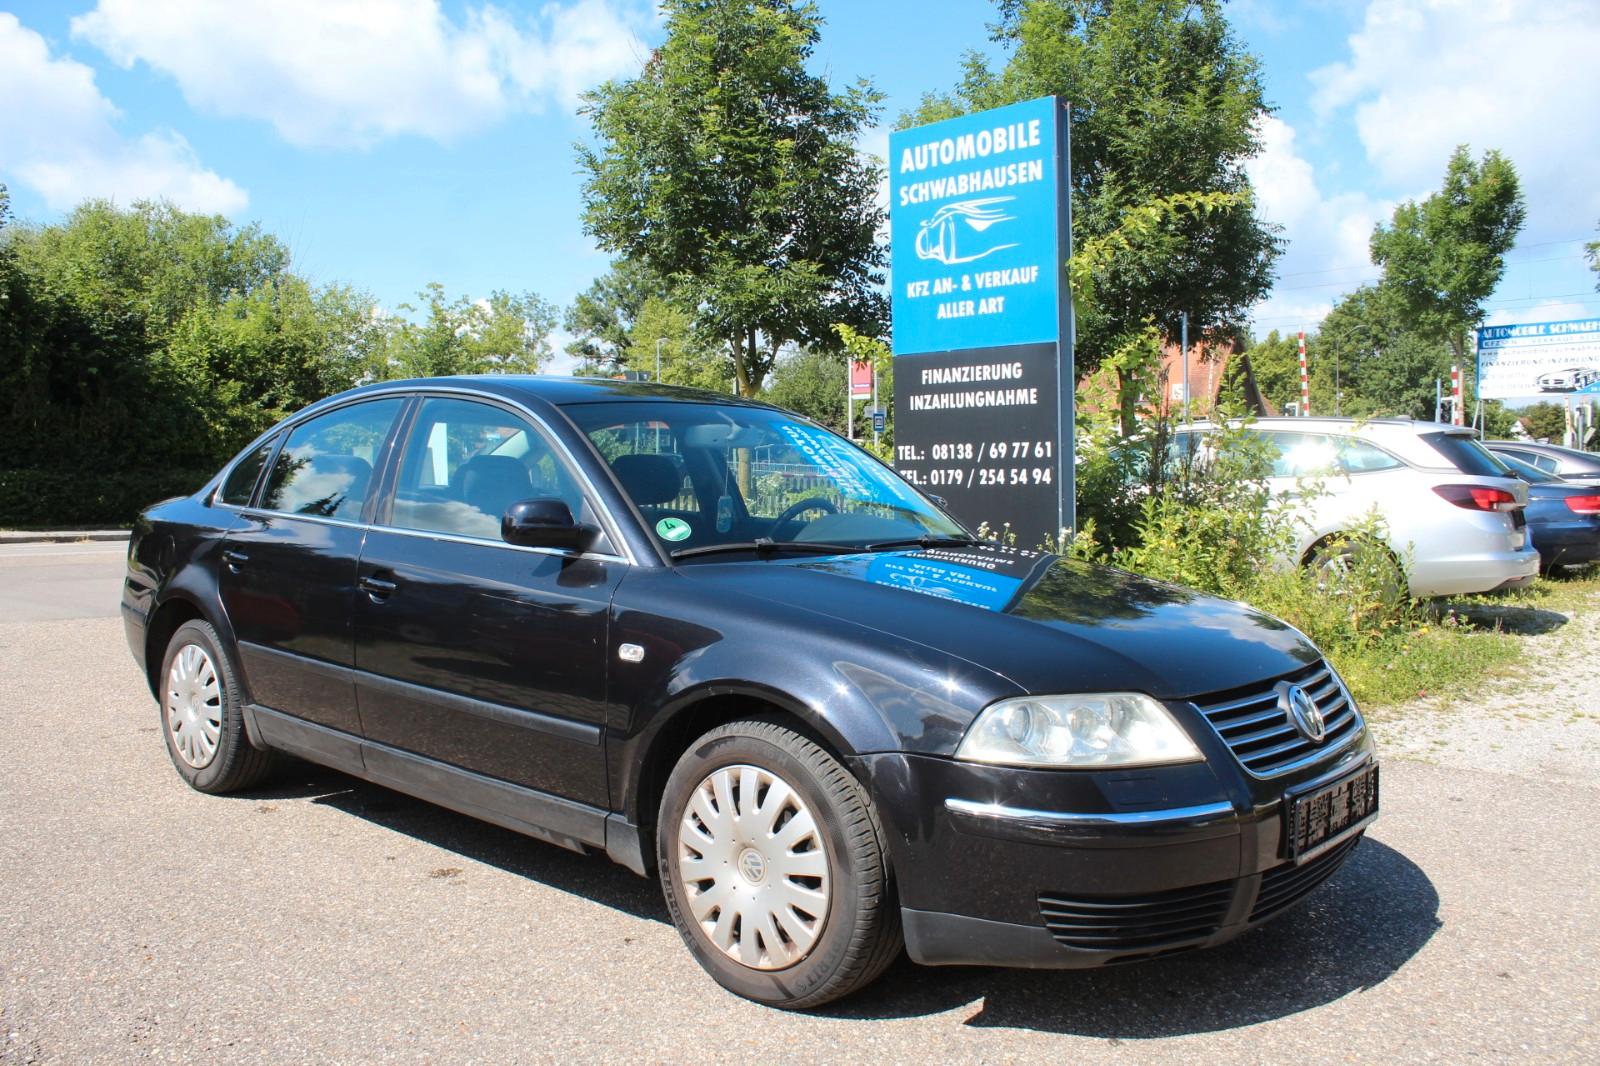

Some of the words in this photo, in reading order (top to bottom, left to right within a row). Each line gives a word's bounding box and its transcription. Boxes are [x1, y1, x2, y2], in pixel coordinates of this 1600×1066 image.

[900, 119, 1040, 173] AUTOMOBILE
[900, 159, 1042, 206] SCHWABHAUSEN
[907, 281, 929, 298] KFZ
[933, 277, 957, 295] AN-
[961, 274, 972, 291] &
[975, 266, 1039, 289] VERKAUF
[937, 301, 974, 319] ALLER
[978, 296, 1005, 315] ART
[921, 362, 1022, 384] FINANZIERUNG
[910, 388, 1037, 411] INZAHLUNGNAHME
[898, 445, 925, 460] TEL.:
[932, 443, 973, 460] 08138
[977, 442, 985, 463] /
[989, 442, 1007, 458] 69
[1012, 442, 1029, 458] 77
[1034, 441, 1052, 458] 61
[930, 469, 963, 485] 0179
[967, 469, 975, 488] /
[979, 469, 1005, 485] 254
[1010, 469, 1028, 485] 54
[1032, 468, 1052, 485] 94
[664, 520, 676, 530] 4
